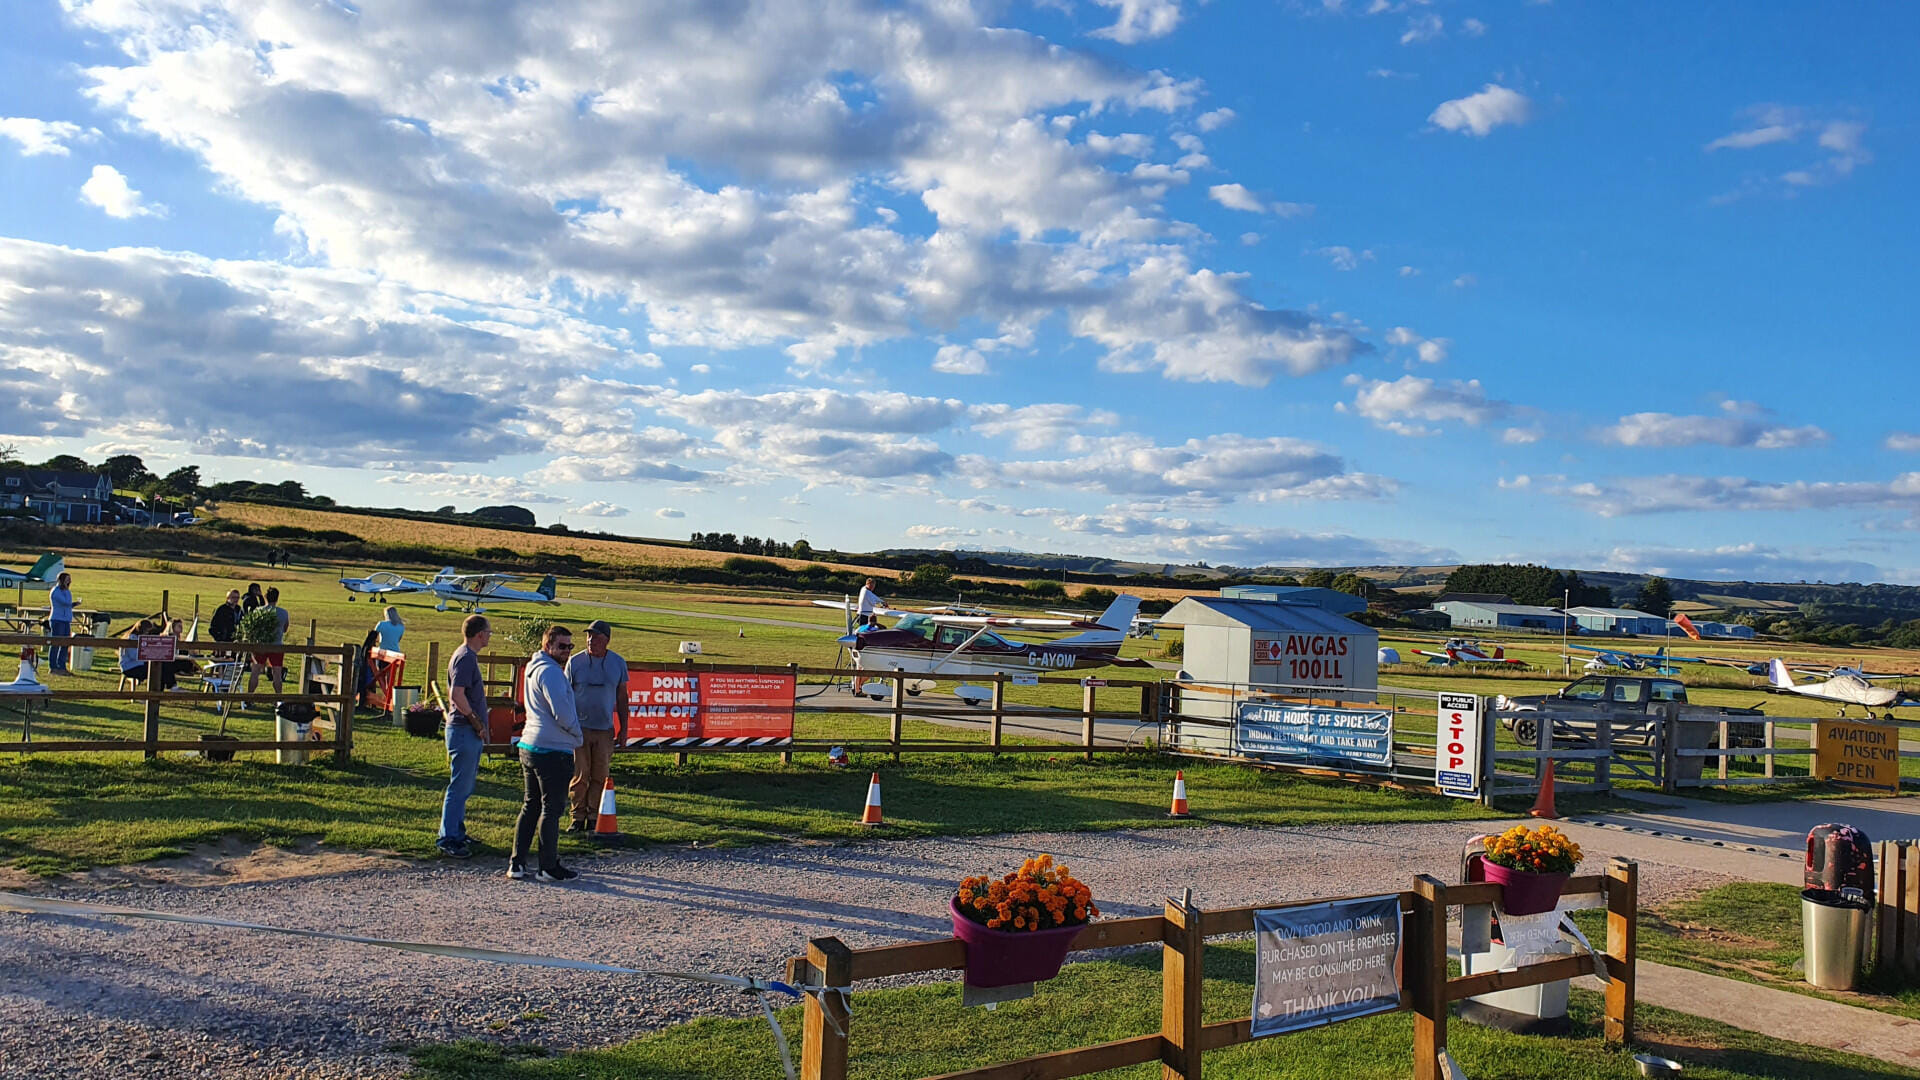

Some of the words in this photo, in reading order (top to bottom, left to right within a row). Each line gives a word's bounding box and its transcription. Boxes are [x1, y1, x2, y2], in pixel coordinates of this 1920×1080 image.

[1285, 635, 1347, 656] AVGAS
[1028, 651, 1077, 668] G-AYOW
[1289, 659, 1342, 679] 100LL
[653, 676, 698, 689] DON'T
[654, 690, 698, 704] CRIME
[628, 706, 667, 718] TAKE
[670, 706, 698, 718] OFF
[1263, 709, 1282, 722] THE
[1284, 711, 1316, 725] HOUSE
[1318, 713, 1332, 727] OF
[1334, 714, 1363, 729] SPICE
[1248, 729, 1273, 740] INDIAN
[1273, 731, 1318, 745] RESTAURANT
[1320, 735, 1335, 745] AND
[1337, 737, 1355, 747] TAKE
[1357, 738, 1378, 749] AWAY
[1447, 712, 1464, 769] STOP
[1828, 727, 1887, 745] AVIATION
[1843, 744, 1897, 761] MUSEUM
[1837, 762, 1875, 779] OPEN
[1276, 926, 1300, 940] ONLY
[1304, 921, 1331, 937] FOOD
[1333, 918, 1353, 933] AND
[1355, 914, 1383, 930] DRINK
[1261, 944, 1317, 963] PURCHASED
[1320, 942, 1335, 956] ON
[1337, 939, 1355, 954] THE
[1357, 932, 1396, 950] PREMISES
[1272, 970, 1293, 985] MAY
[1295, 967, 1306, 981] BE
[1309, 958, 1362, 978] CONSUMED
[1365, 954, 1385, 970] HERE
[1283, 991, 1339, 1020] THANK
[1342, 983, 1376, 1008] YOU
